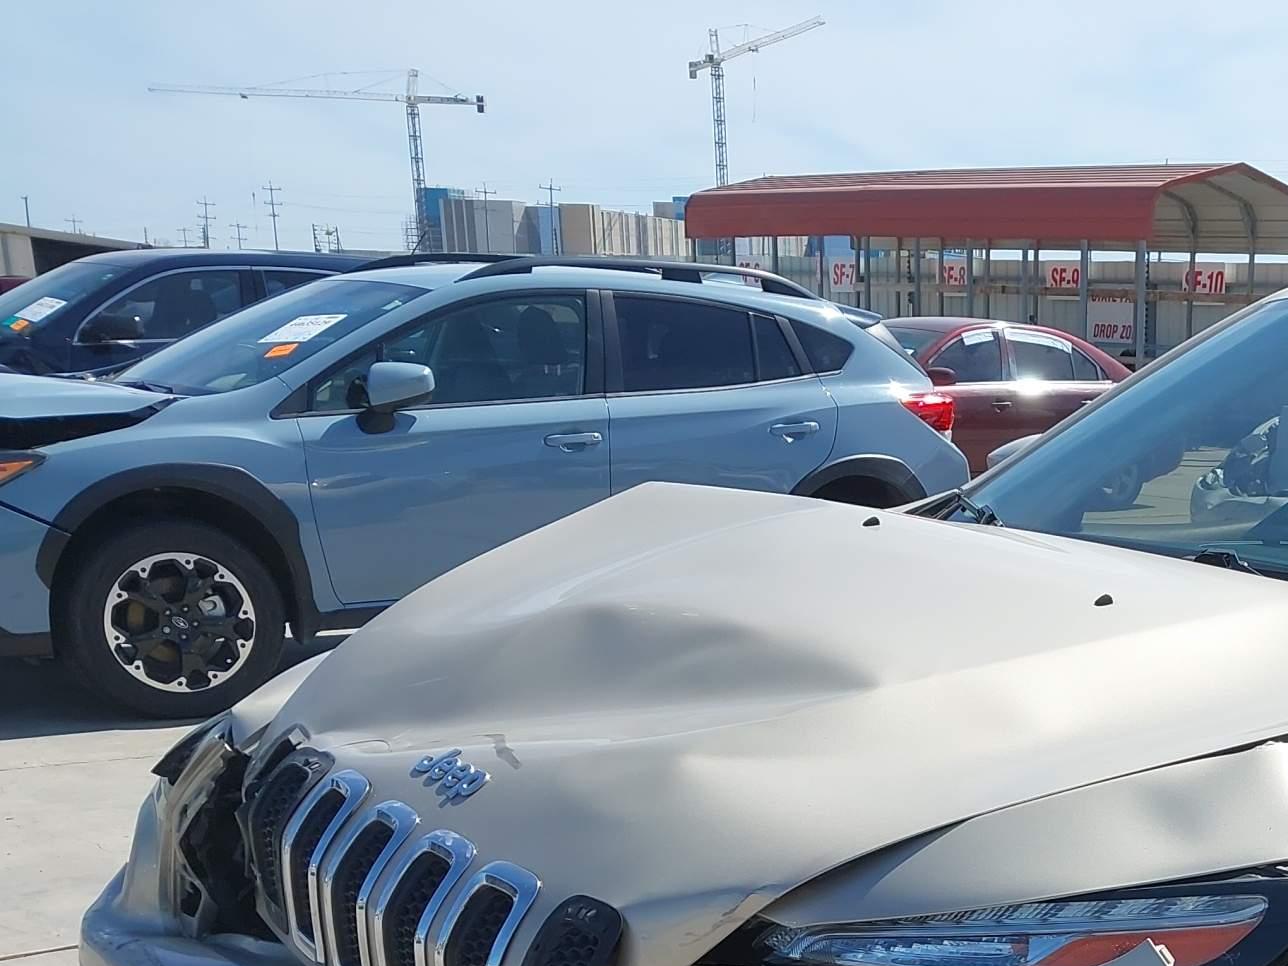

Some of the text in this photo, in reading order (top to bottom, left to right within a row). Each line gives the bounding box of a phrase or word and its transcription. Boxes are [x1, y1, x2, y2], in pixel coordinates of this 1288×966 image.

[832, 263, 856, 286] SF-7
[1050, 267, 1080, 288] SF-9
[1093, 323, 1118, 339] DROP
[415, 748, 490, 808] Jeep
